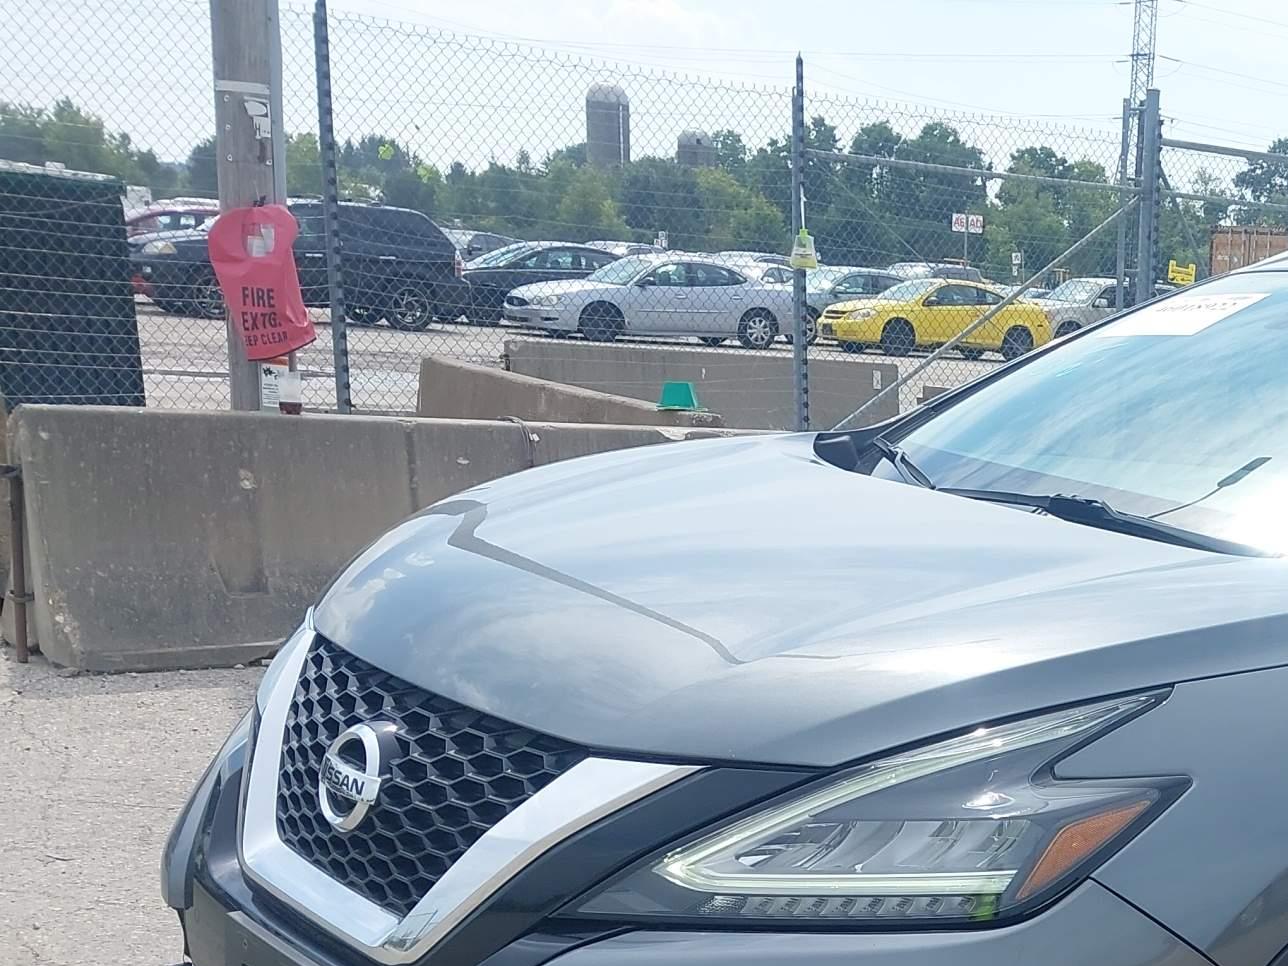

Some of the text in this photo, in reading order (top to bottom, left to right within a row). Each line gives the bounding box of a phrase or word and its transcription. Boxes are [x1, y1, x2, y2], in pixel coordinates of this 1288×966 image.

[241, 286, 276, 308] FIRE
[241, 311, 282, 331] EXTG.
[244, 331, 288, 347] EEP CLEAR
